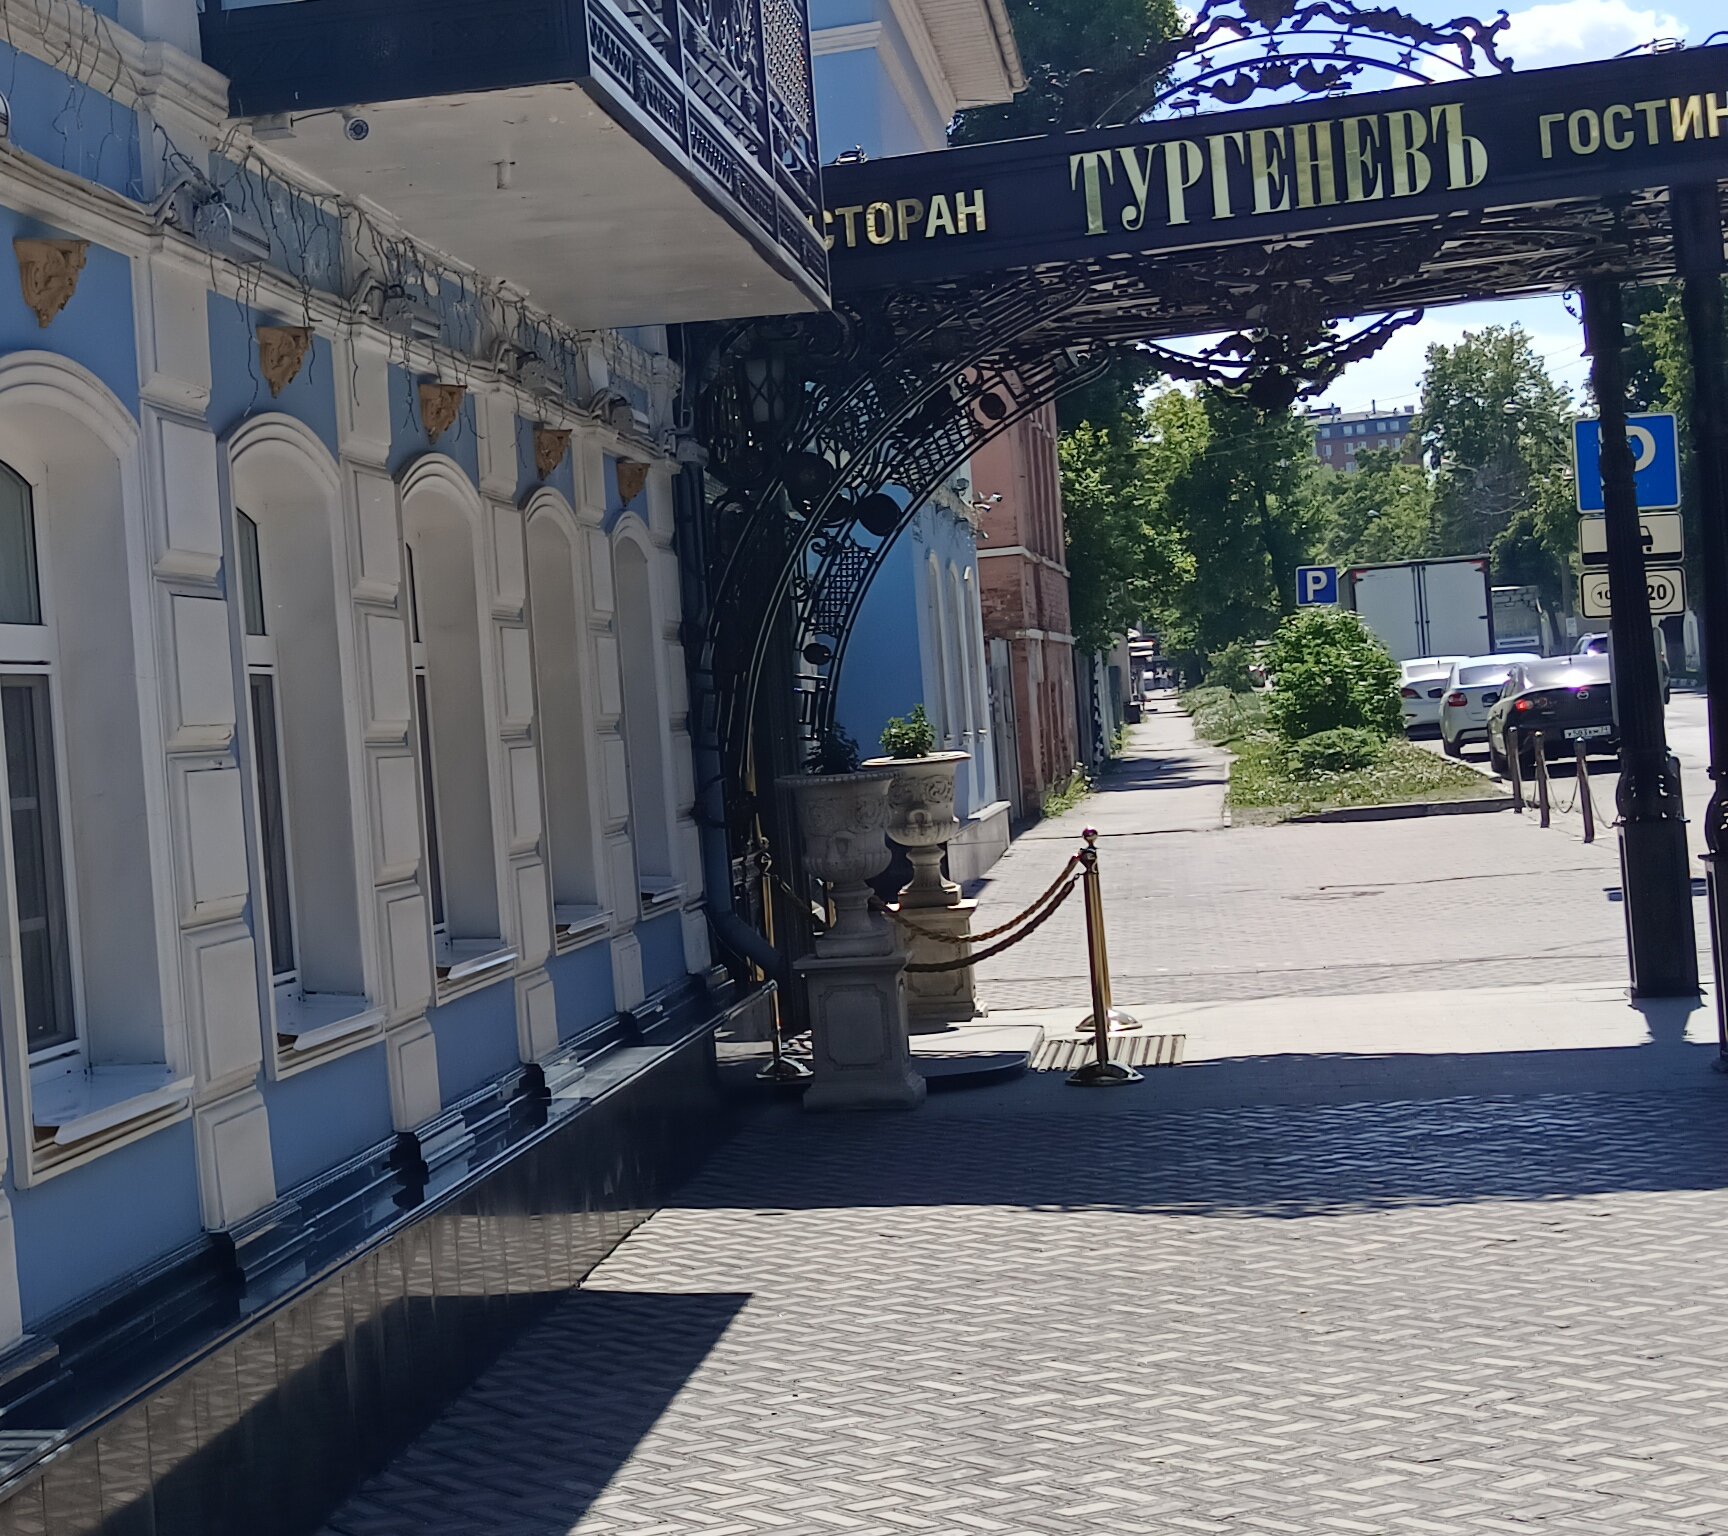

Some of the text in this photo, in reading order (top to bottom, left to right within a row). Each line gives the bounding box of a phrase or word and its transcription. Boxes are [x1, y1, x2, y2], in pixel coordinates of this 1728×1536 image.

[1069, 103, 1488, 235] ТУРГЕНЕВЪ
[1539, 91, 1728, 159] ГОСТИН
[1306, 570, 1328, 602] P
[1647, 584, 1667, 601] 20
